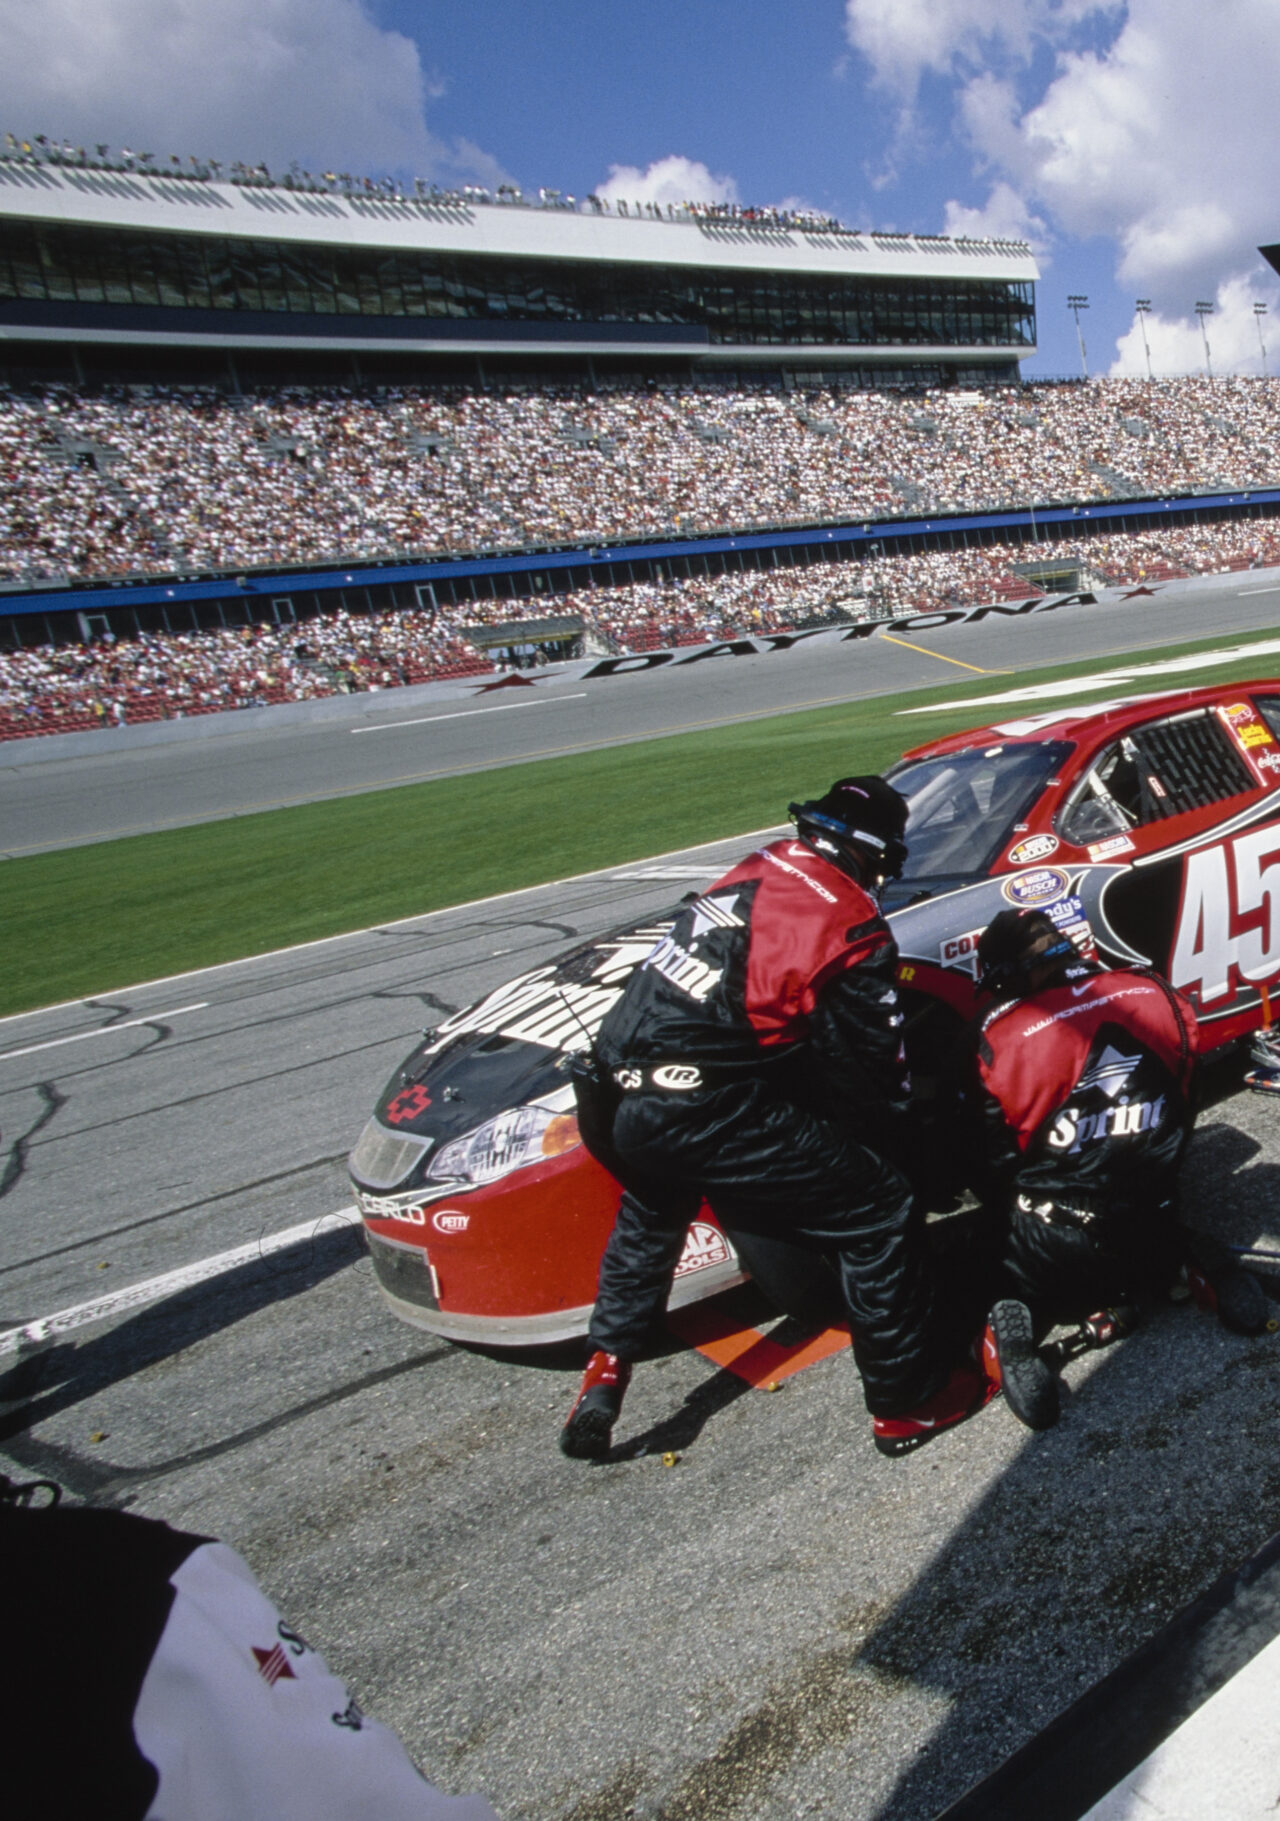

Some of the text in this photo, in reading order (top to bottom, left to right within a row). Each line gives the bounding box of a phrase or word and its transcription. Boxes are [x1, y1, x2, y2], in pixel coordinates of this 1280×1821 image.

[579, 592, 1099, 681] DAYTONA
[1018, 843, 1054, 862] 2000
[1020, 878, 1053, 898] BUSCH
[641, 934, 724, 1000] print
[613, 1069, 643, 1089] CS
[1047, 1093, 1167, 1155] Sprint
[441, 1215, 471, 1231] PETTY
[674, 1249, 726, 1274] OOLS
